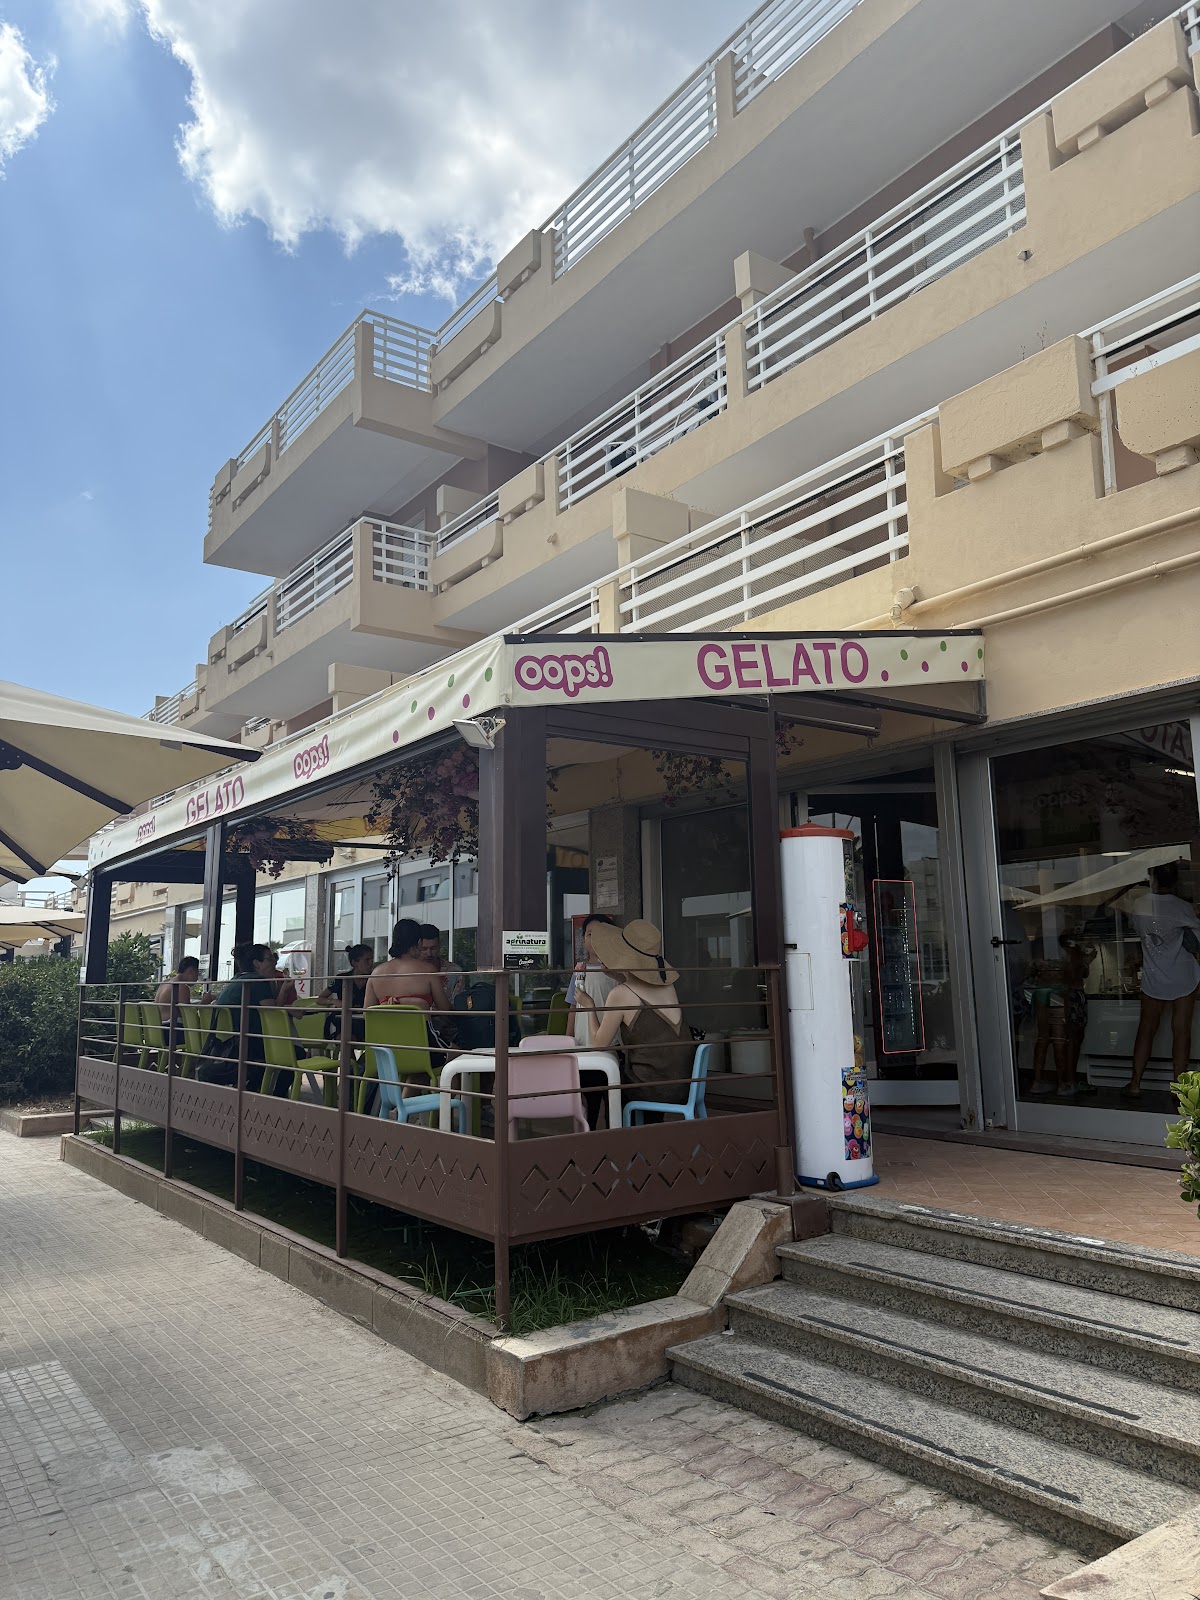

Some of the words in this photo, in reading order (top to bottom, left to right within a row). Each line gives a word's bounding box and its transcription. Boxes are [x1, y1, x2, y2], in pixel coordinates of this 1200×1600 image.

[515, 646, 613, 697] oops!
[697, 641, 868, 691] GELATO
[185, 775, 245, 827] GELATO
[293, 734, 330, 780] oops!
